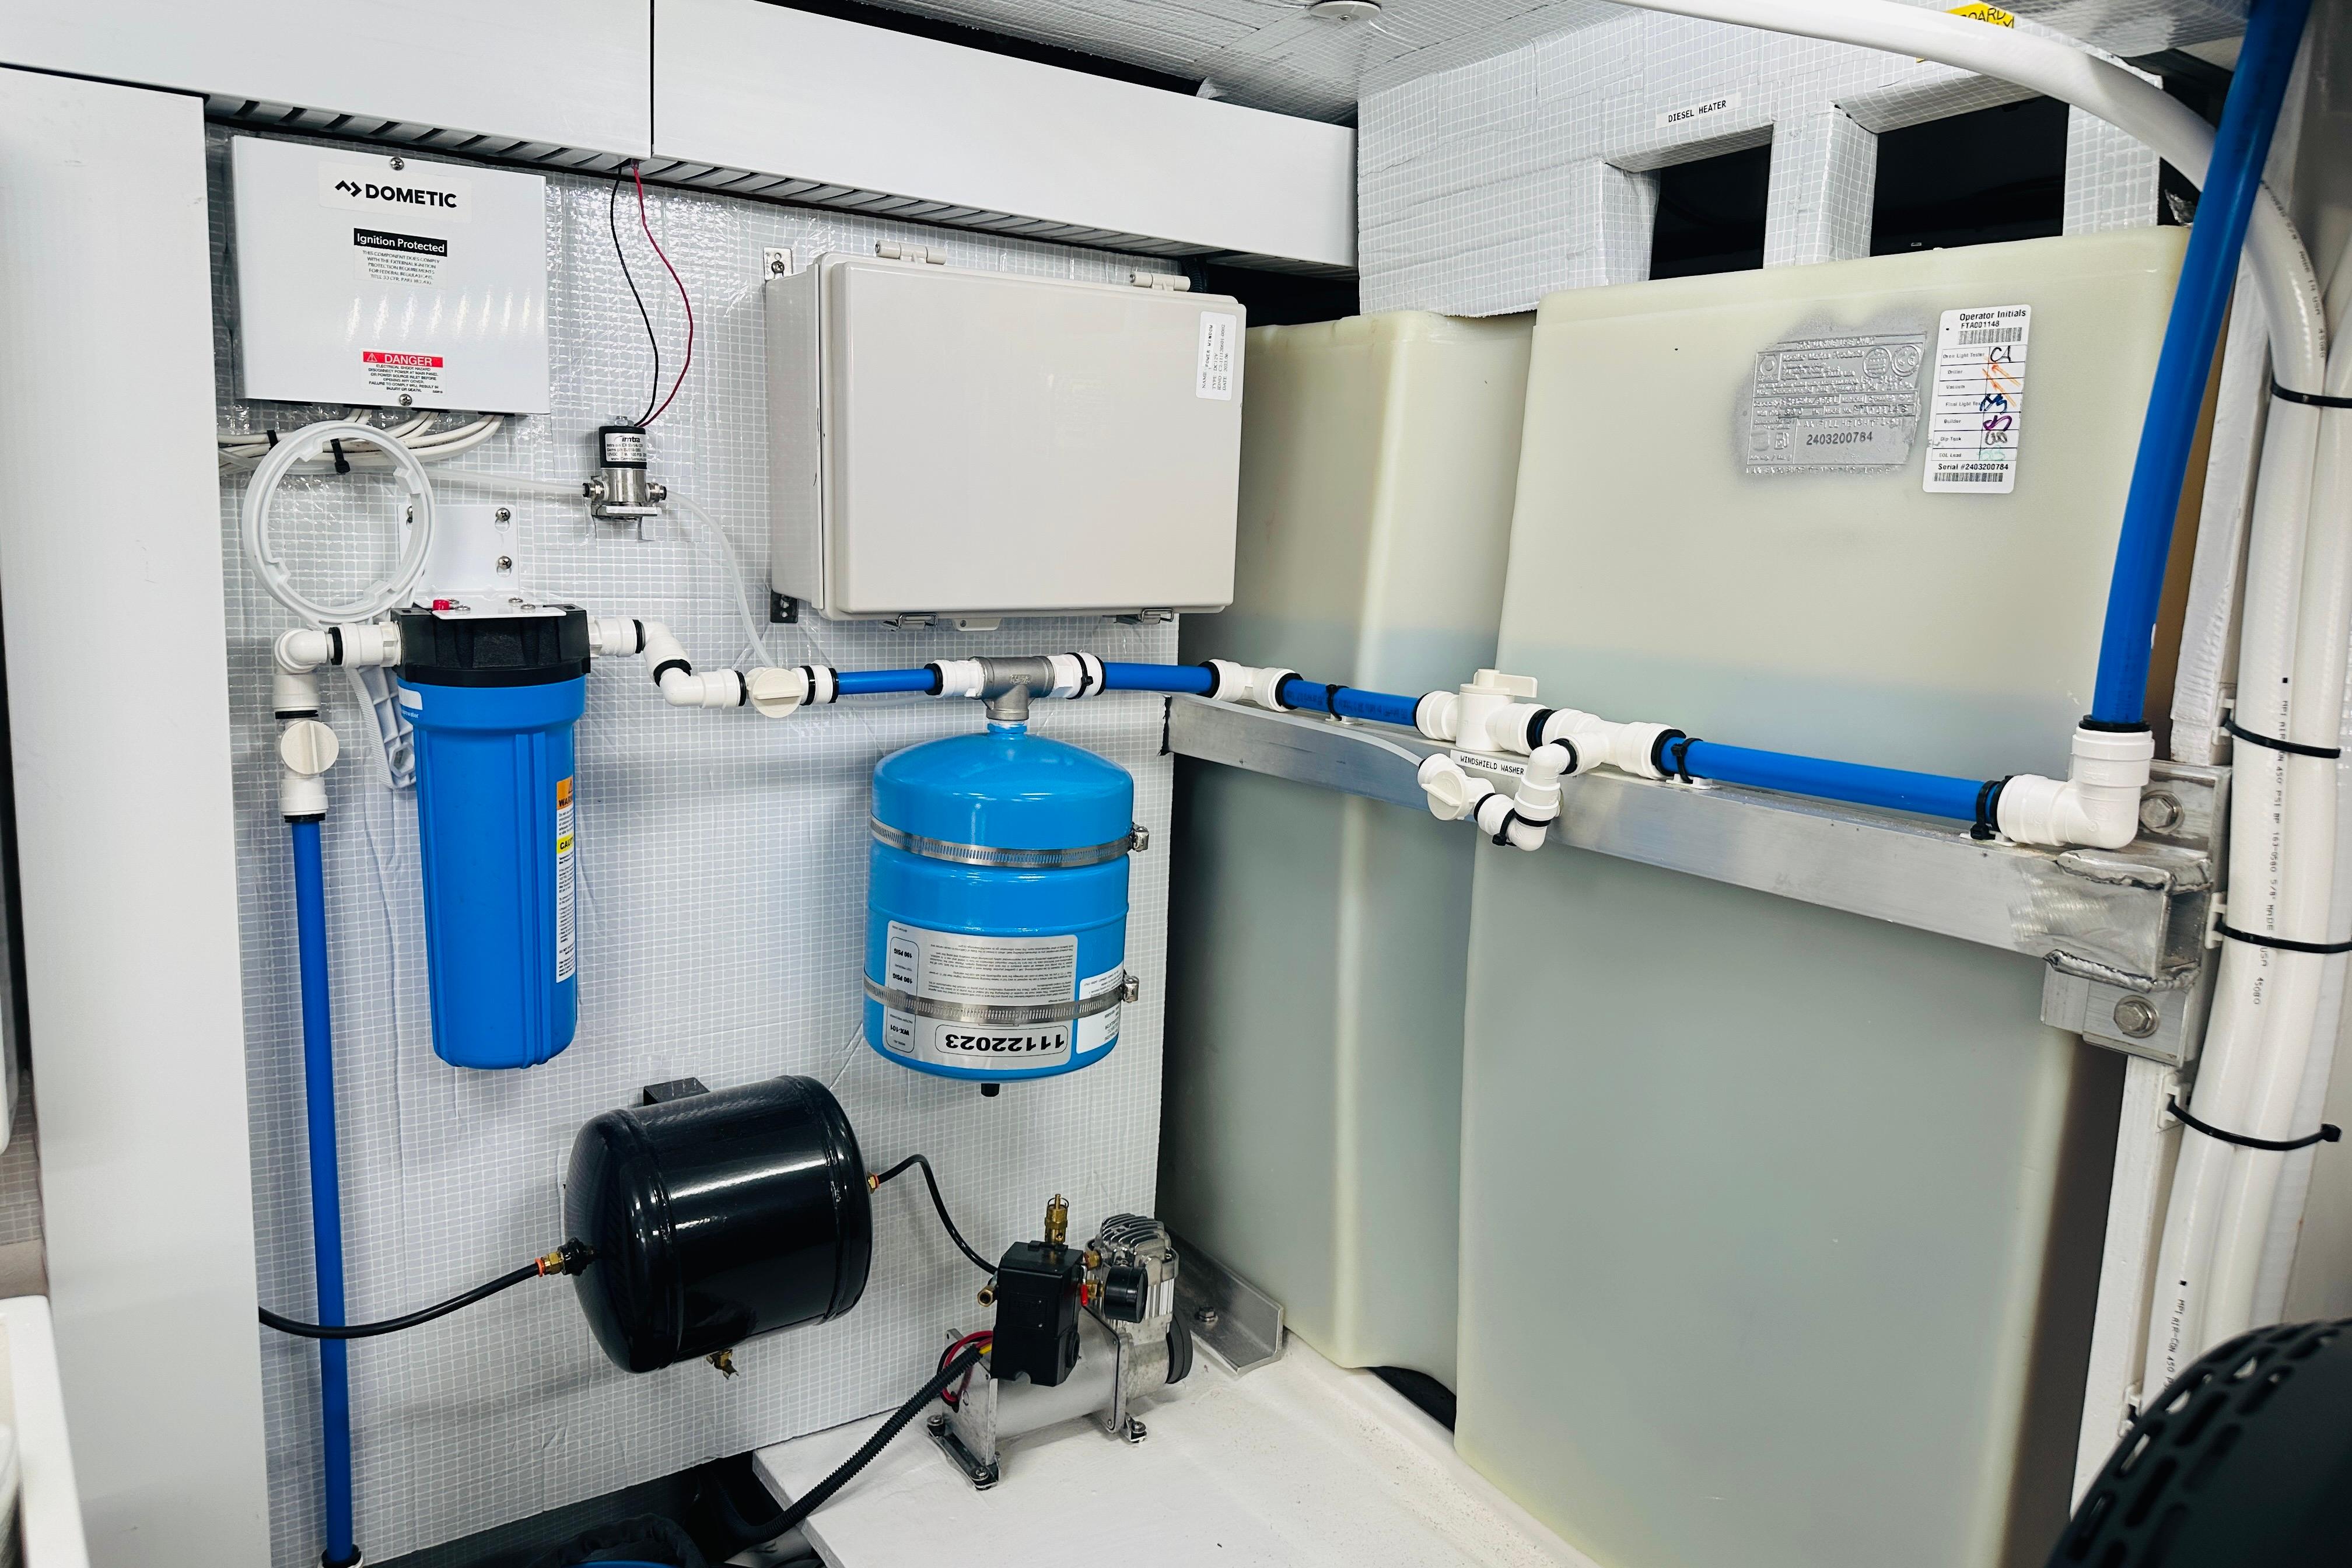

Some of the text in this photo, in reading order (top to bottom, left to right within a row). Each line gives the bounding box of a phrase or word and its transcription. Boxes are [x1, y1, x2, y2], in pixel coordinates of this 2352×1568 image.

[1668, 100, 1726, 123] DIESEL HEATER
[366, 184, 457, 208] DOMETIC
[357, 233, 444, 253] Ignition Protected
[1960, 309, 2026, 321] Operator Initials
[385, 354, 432, 366] DANGER
[1806, 431, 1873, 446] 2403200784
[1460, 755, 1524, 775] WINDSHIELD WASHER
[2260, 947, 2268, 967] USA
[890, 1024, 909, 1036] WX-101
[945, 1034, 1065, 1052] 11122023
